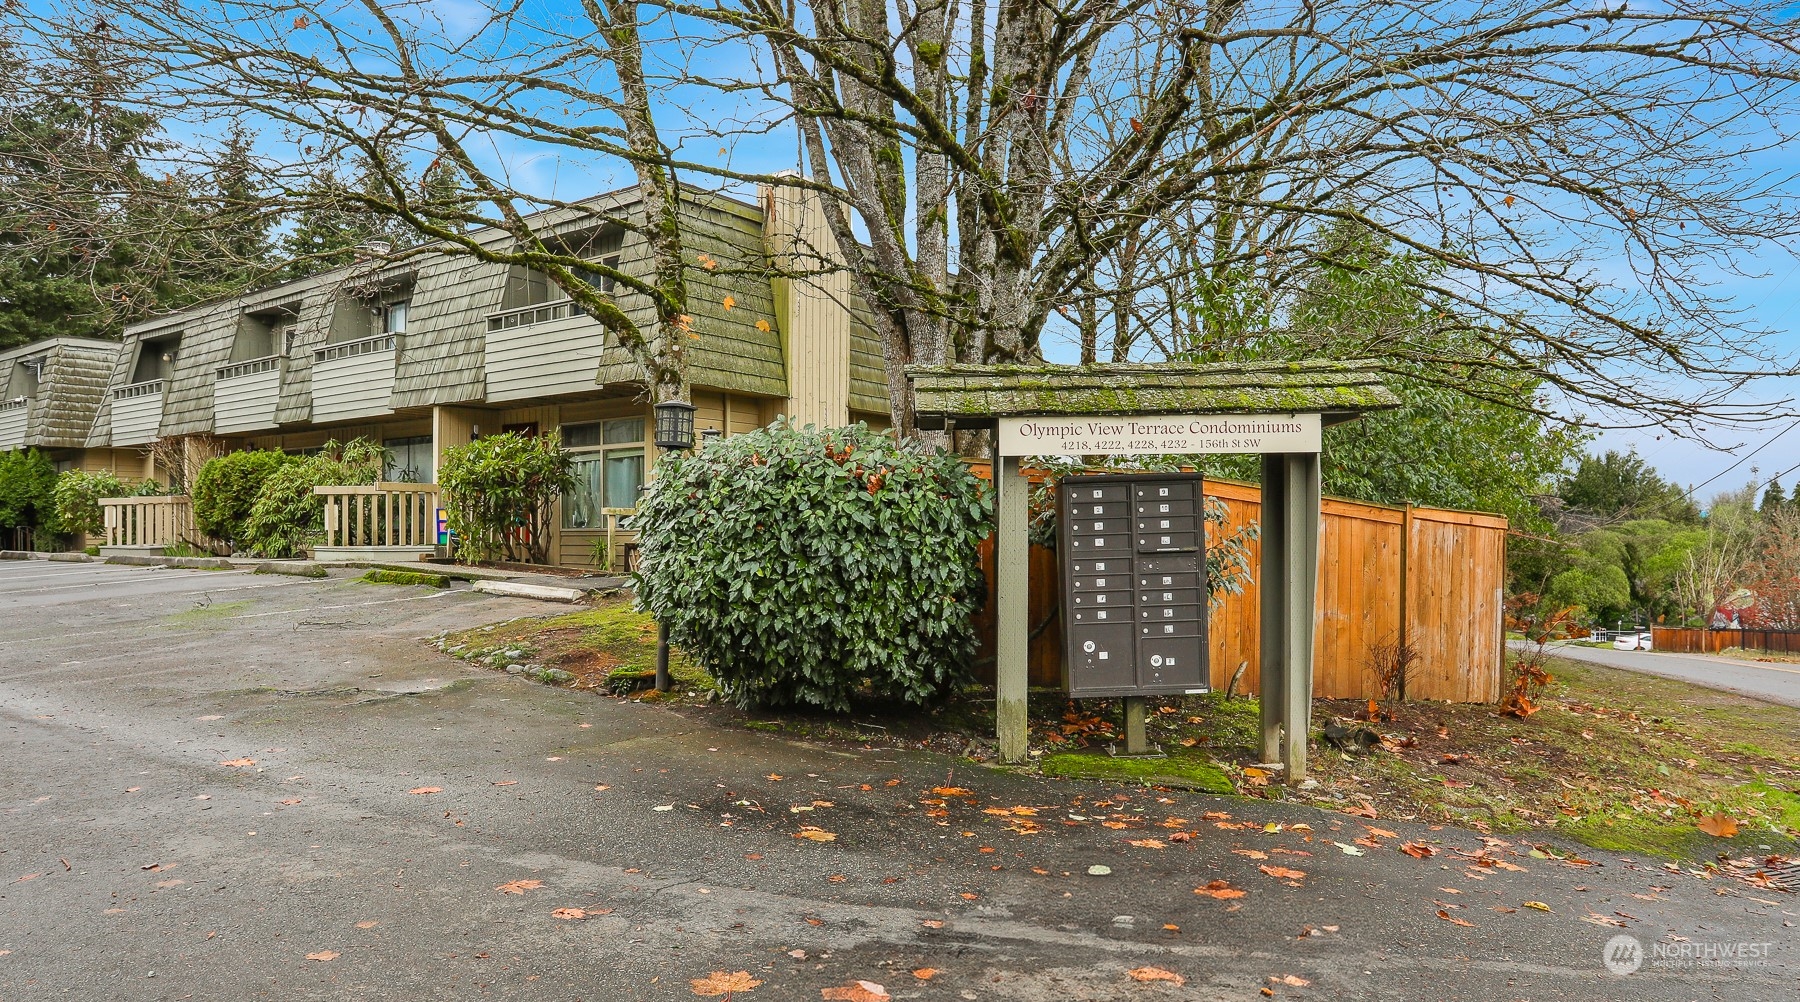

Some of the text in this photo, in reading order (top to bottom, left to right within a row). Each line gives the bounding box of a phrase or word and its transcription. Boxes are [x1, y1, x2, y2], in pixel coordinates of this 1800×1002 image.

[1019, 420, 1302, 439] Olympic View Terrace Condominiums
[1061, 440, 1092, 451] 4218,
[1094, 440, 1125, 451] 4222,
[1127, 440, 1158, 451] 4228,
[1160, 439, 1188, 449] 4232
[1199, 438, 1229, 449] 156th
[1231, 438, 1241, 448] St
[1243, 438, 1262, 448] SW
